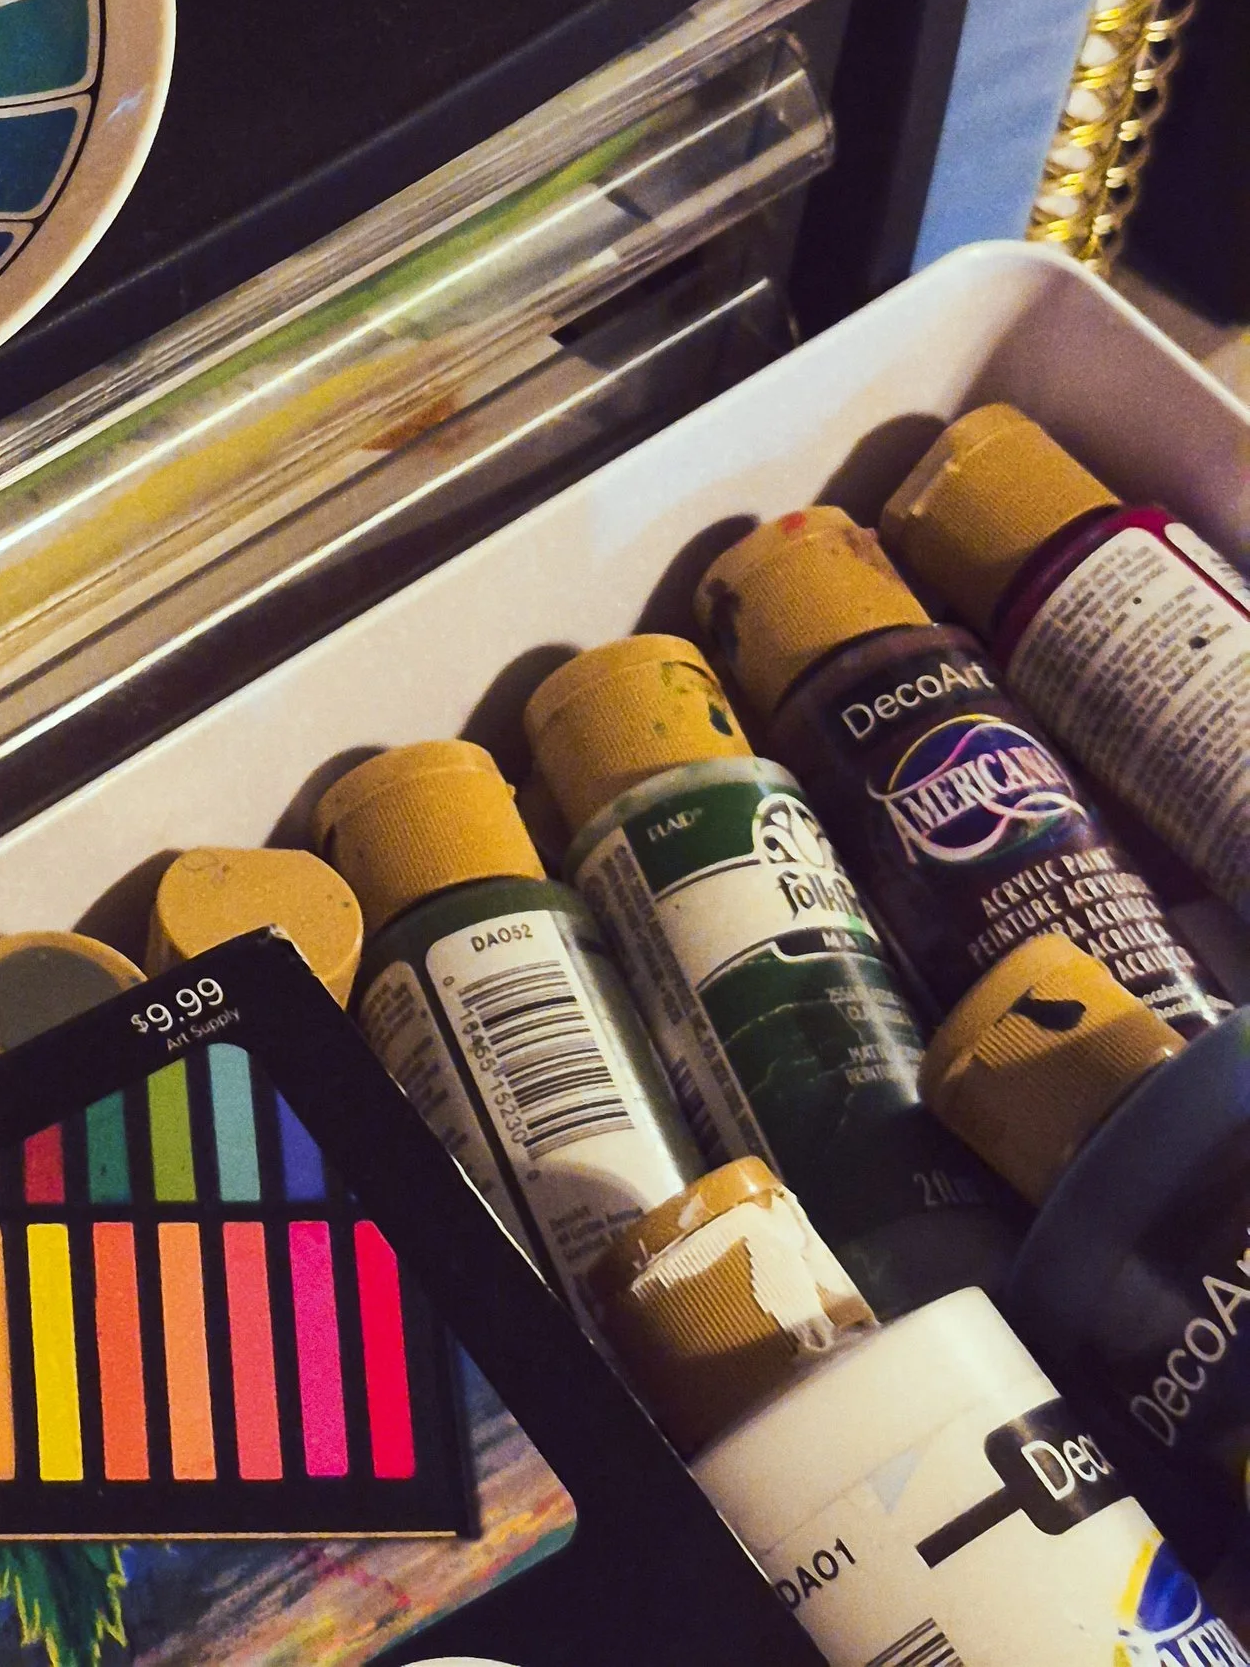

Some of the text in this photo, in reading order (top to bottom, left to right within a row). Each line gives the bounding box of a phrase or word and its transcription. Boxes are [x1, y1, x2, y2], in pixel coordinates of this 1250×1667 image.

[840, 661, 995, 741] DecoArt
[980, 859, 1064, 919] ACRYLIC
[130, 977, 224, 1034] $9.99
[166, 1006, 241, 1052] Art Supply
